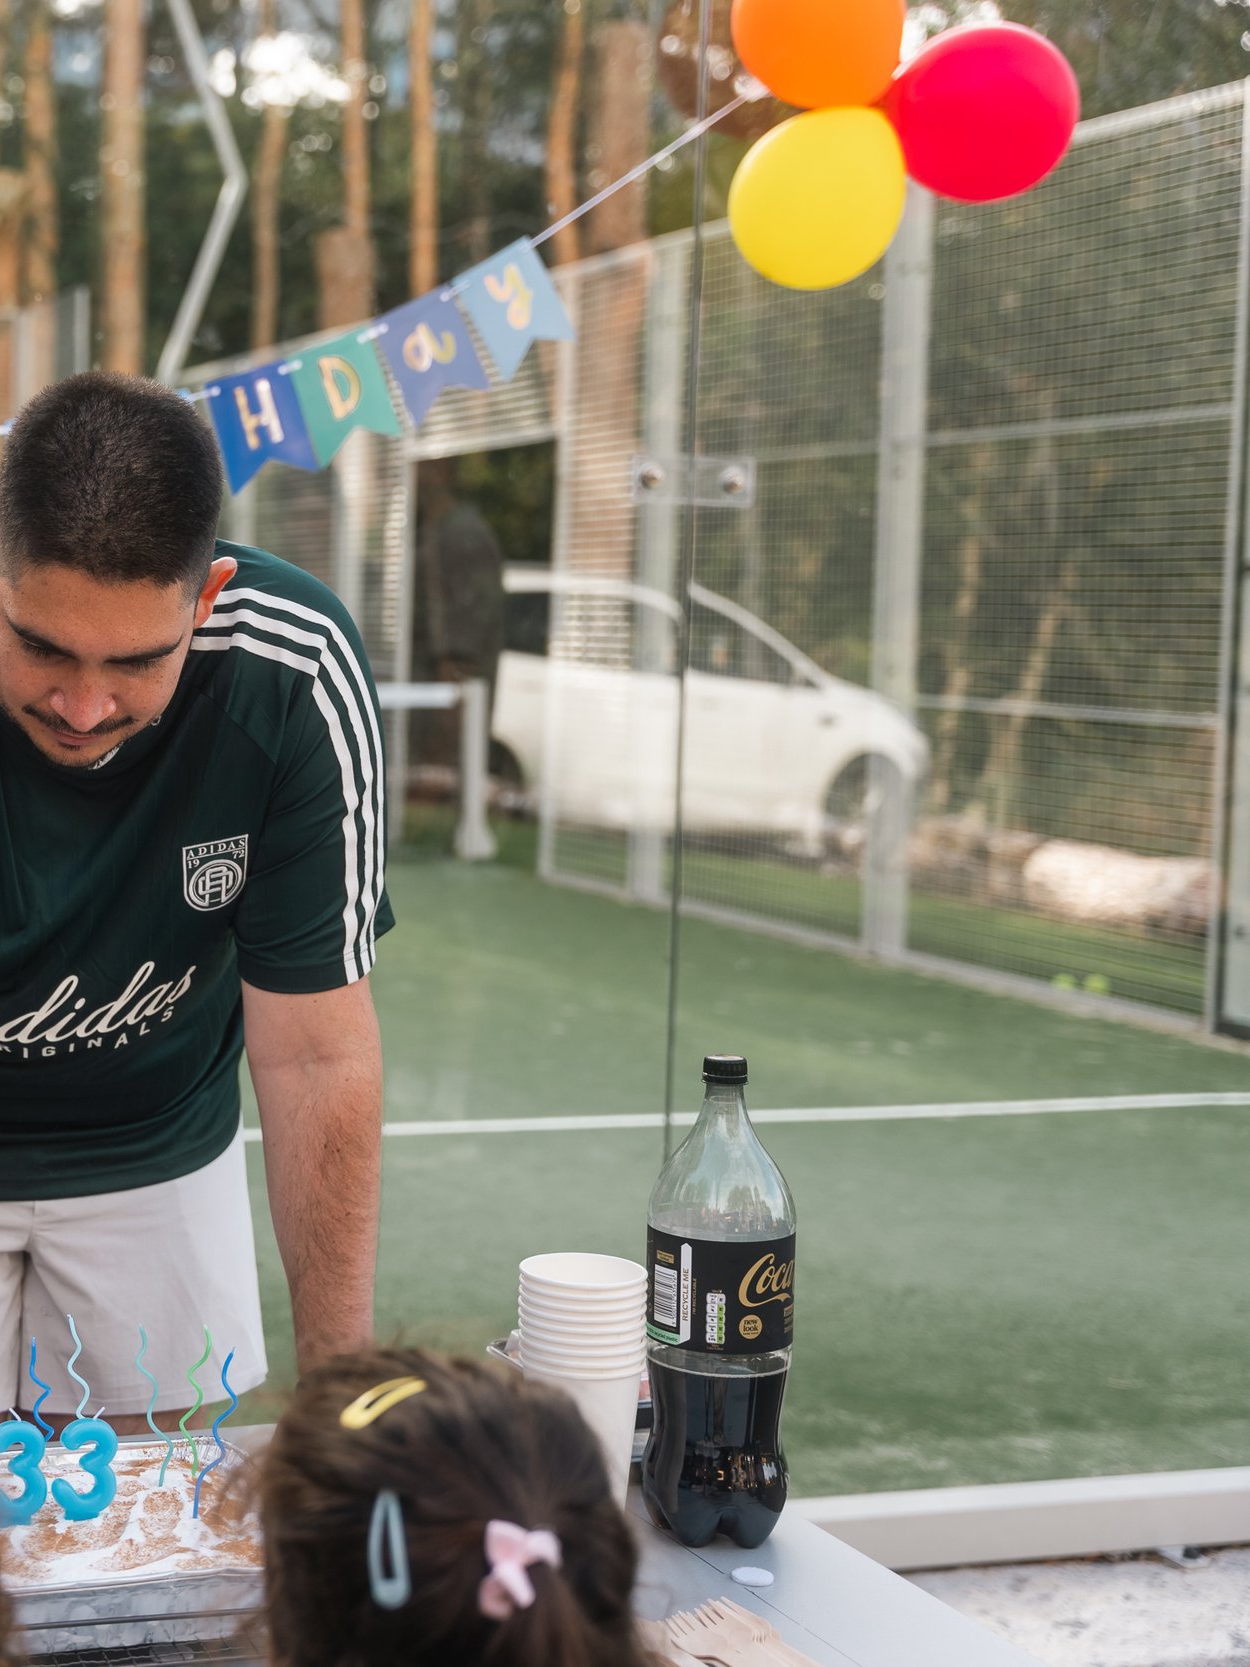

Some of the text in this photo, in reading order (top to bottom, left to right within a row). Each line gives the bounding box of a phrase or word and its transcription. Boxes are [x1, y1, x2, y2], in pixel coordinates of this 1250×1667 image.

[187, 838, 246, 859] ADIDAS
[187, 849, 245, 869] 19 72
[681, 1267, 689, 1322] RECYCLE ME
[743, 1325, 759, 1333] look
